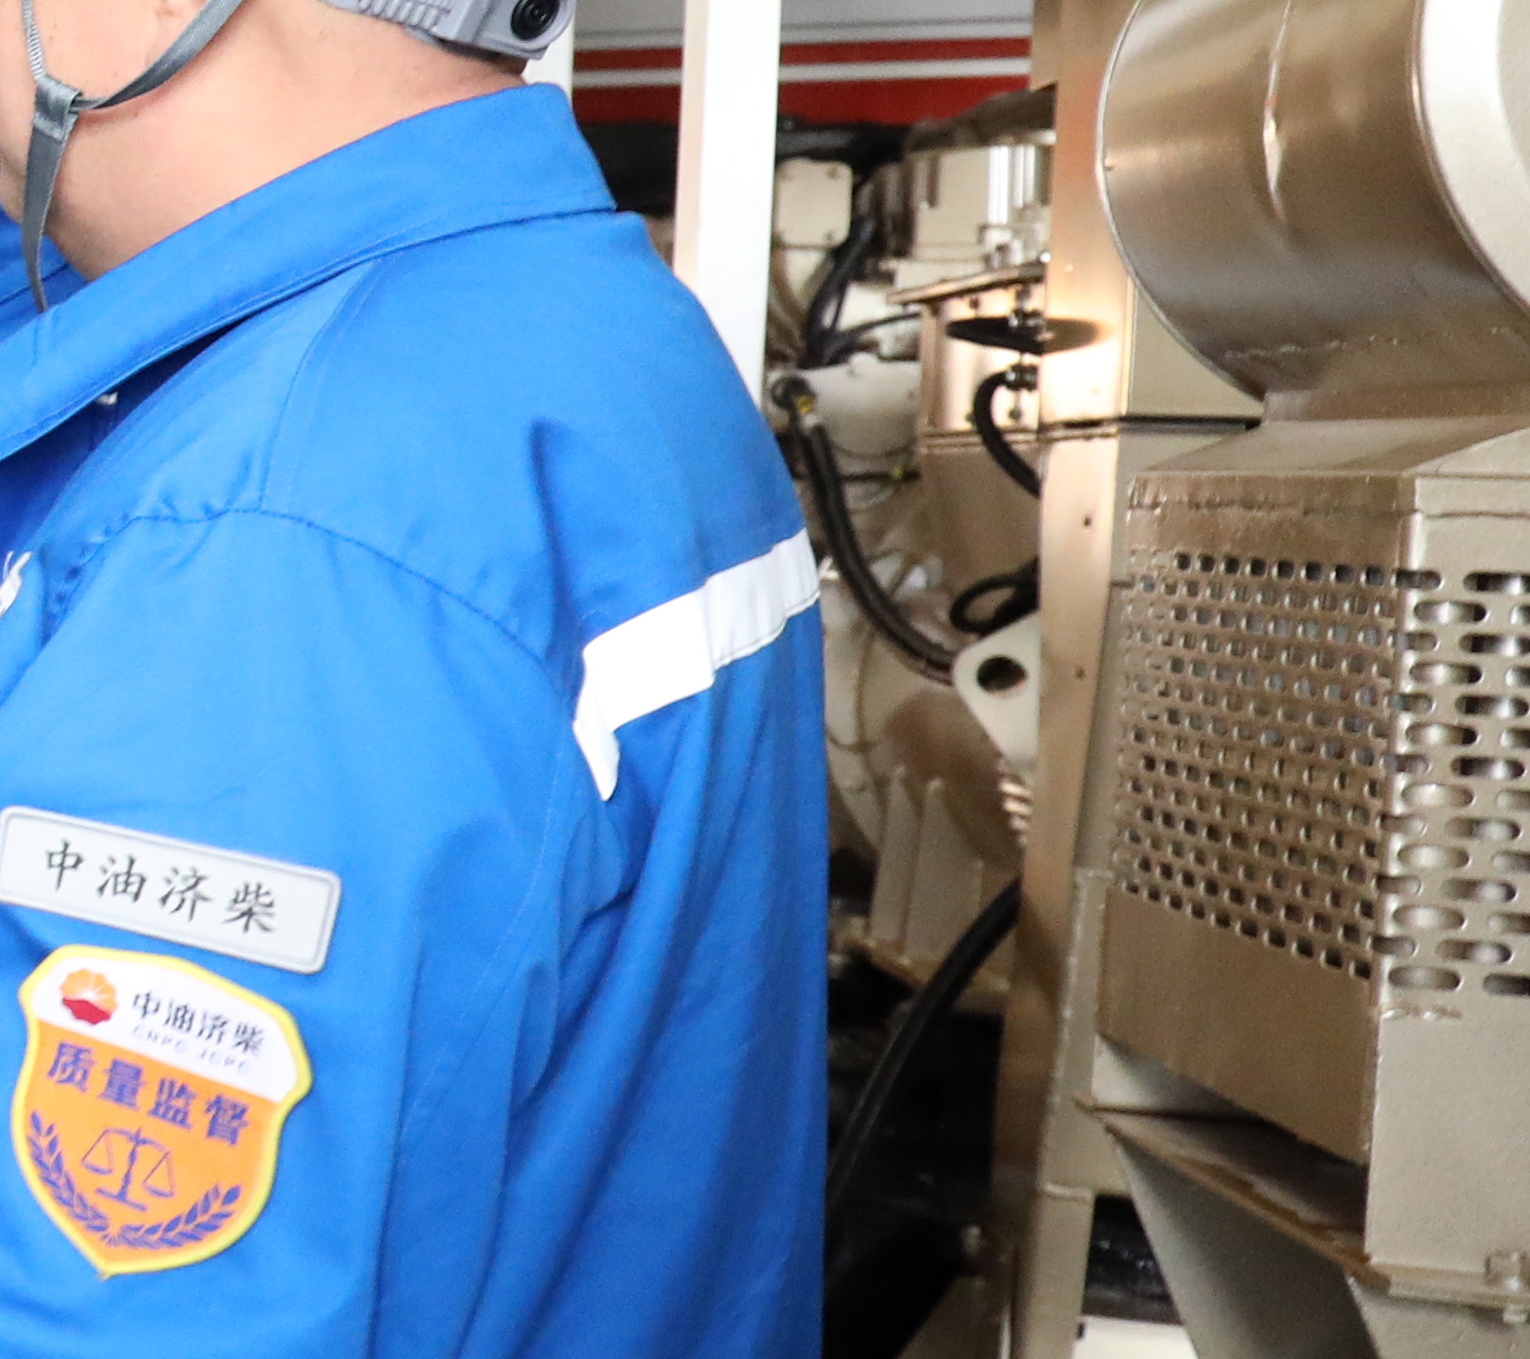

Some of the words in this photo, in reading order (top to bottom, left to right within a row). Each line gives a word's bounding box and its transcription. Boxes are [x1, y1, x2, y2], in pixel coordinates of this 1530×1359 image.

[42, 837, 280, 937] 中油济柴
[131, 990, 266, 1056] 中油济柴
[48, 1040, 252, 1147] 质量监督
